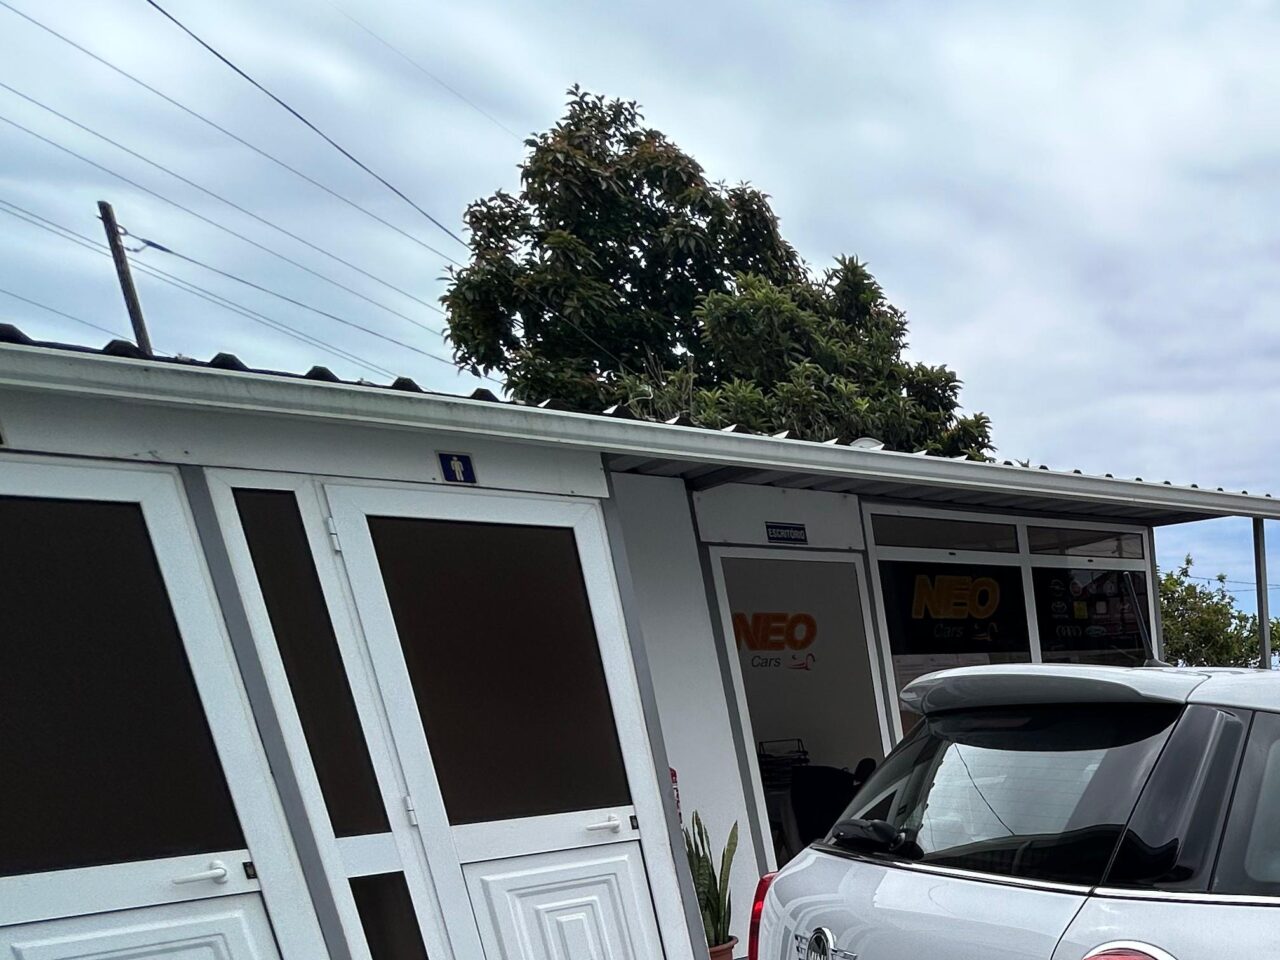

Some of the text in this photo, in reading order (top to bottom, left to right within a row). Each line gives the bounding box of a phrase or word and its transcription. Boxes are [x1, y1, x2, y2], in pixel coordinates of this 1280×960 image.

[912, 574, 1000, 620] NEO
[732, 612, 818, 652] NEO
[751, 655, 782, 668] Cars
